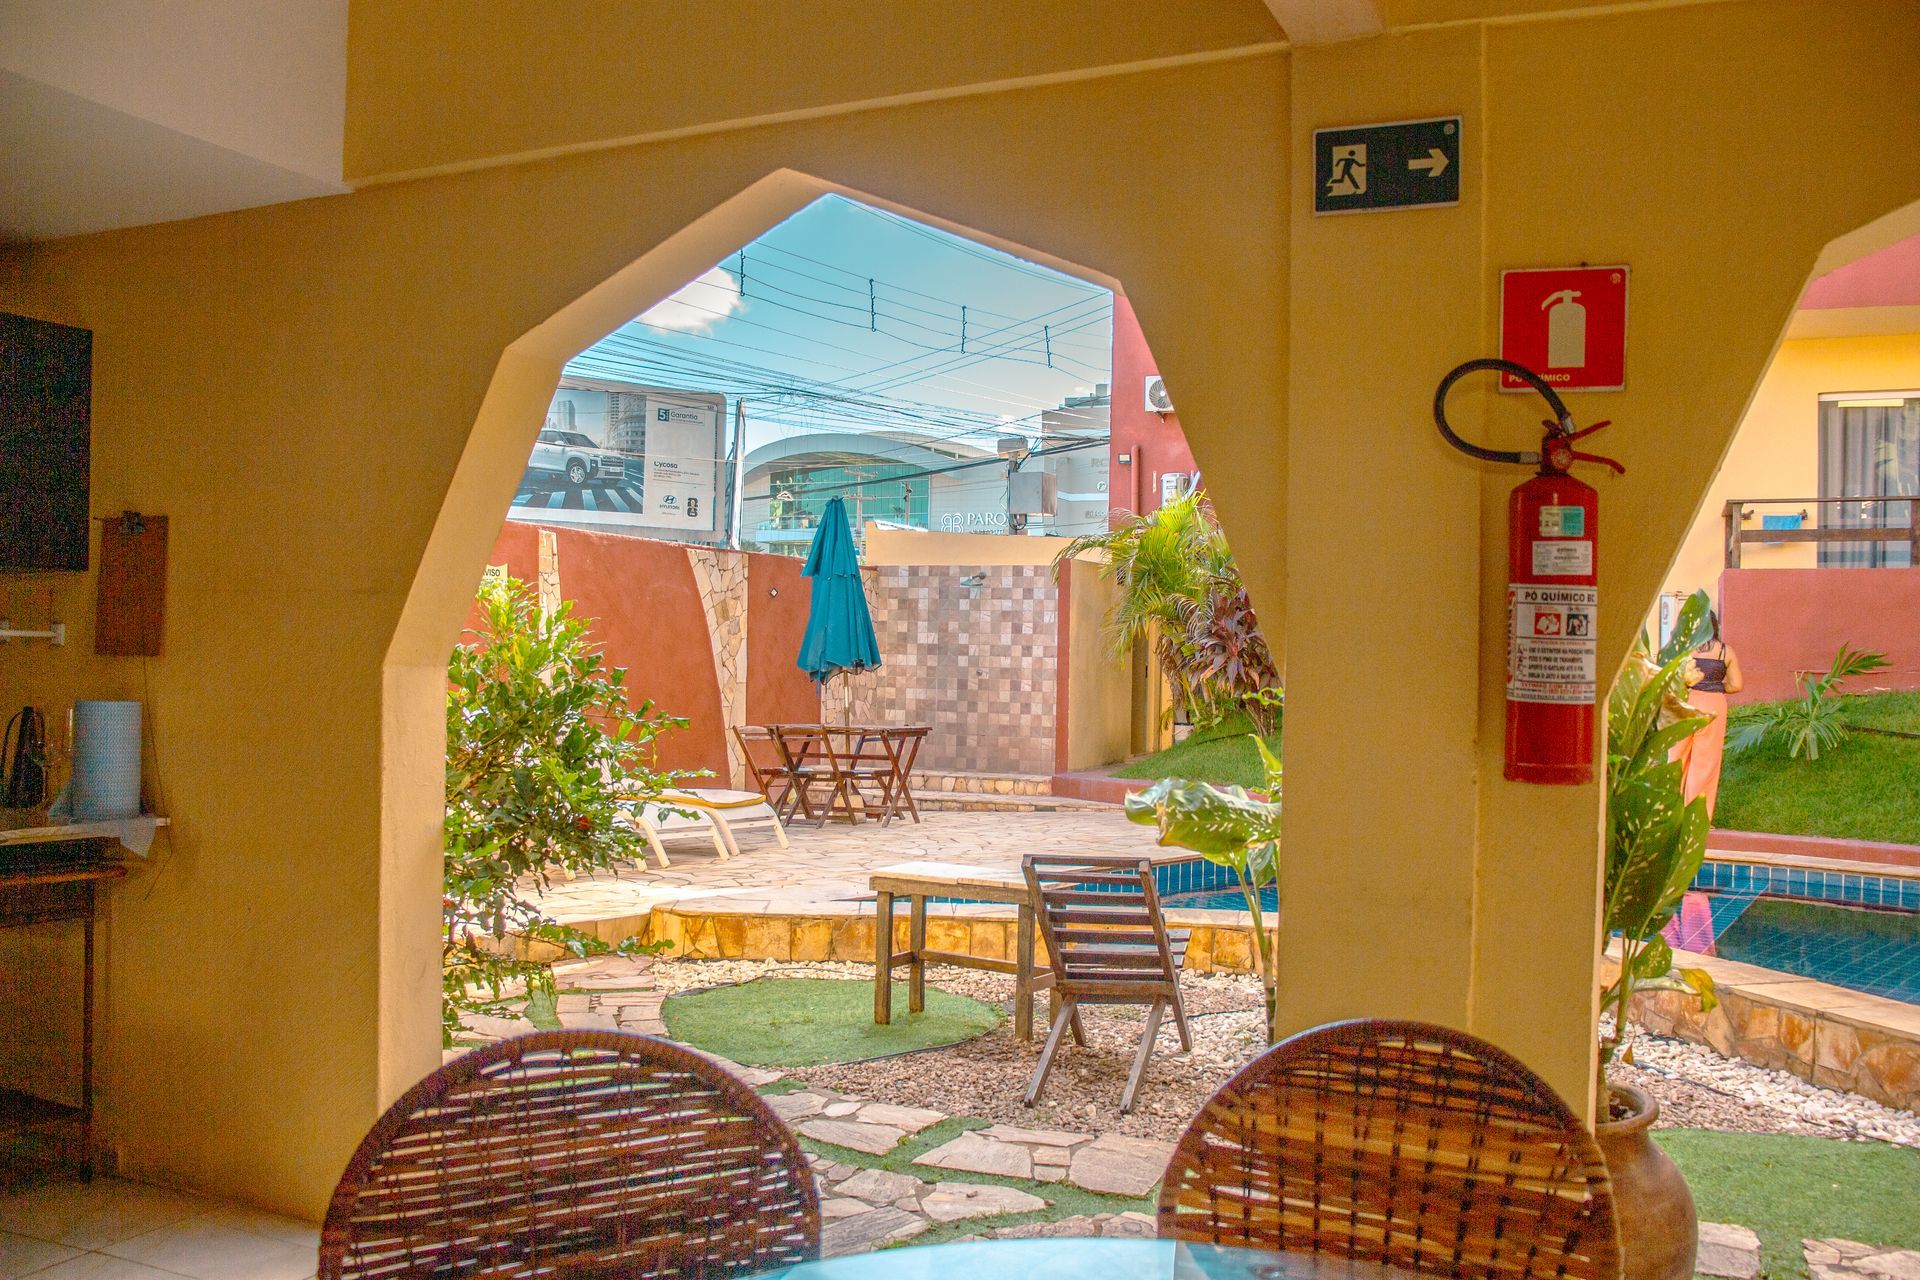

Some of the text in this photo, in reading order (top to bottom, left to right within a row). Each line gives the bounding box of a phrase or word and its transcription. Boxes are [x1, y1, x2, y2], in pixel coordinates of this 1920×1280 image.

[659, 410, 666, 420] 5
[670, 411, 698, 420] Garantia
[967, 512, 1008, 527] PARQ
[1525, 591, 1538, 601] PÓ
[1540, 591, 1585, 602] QUÍMICO
